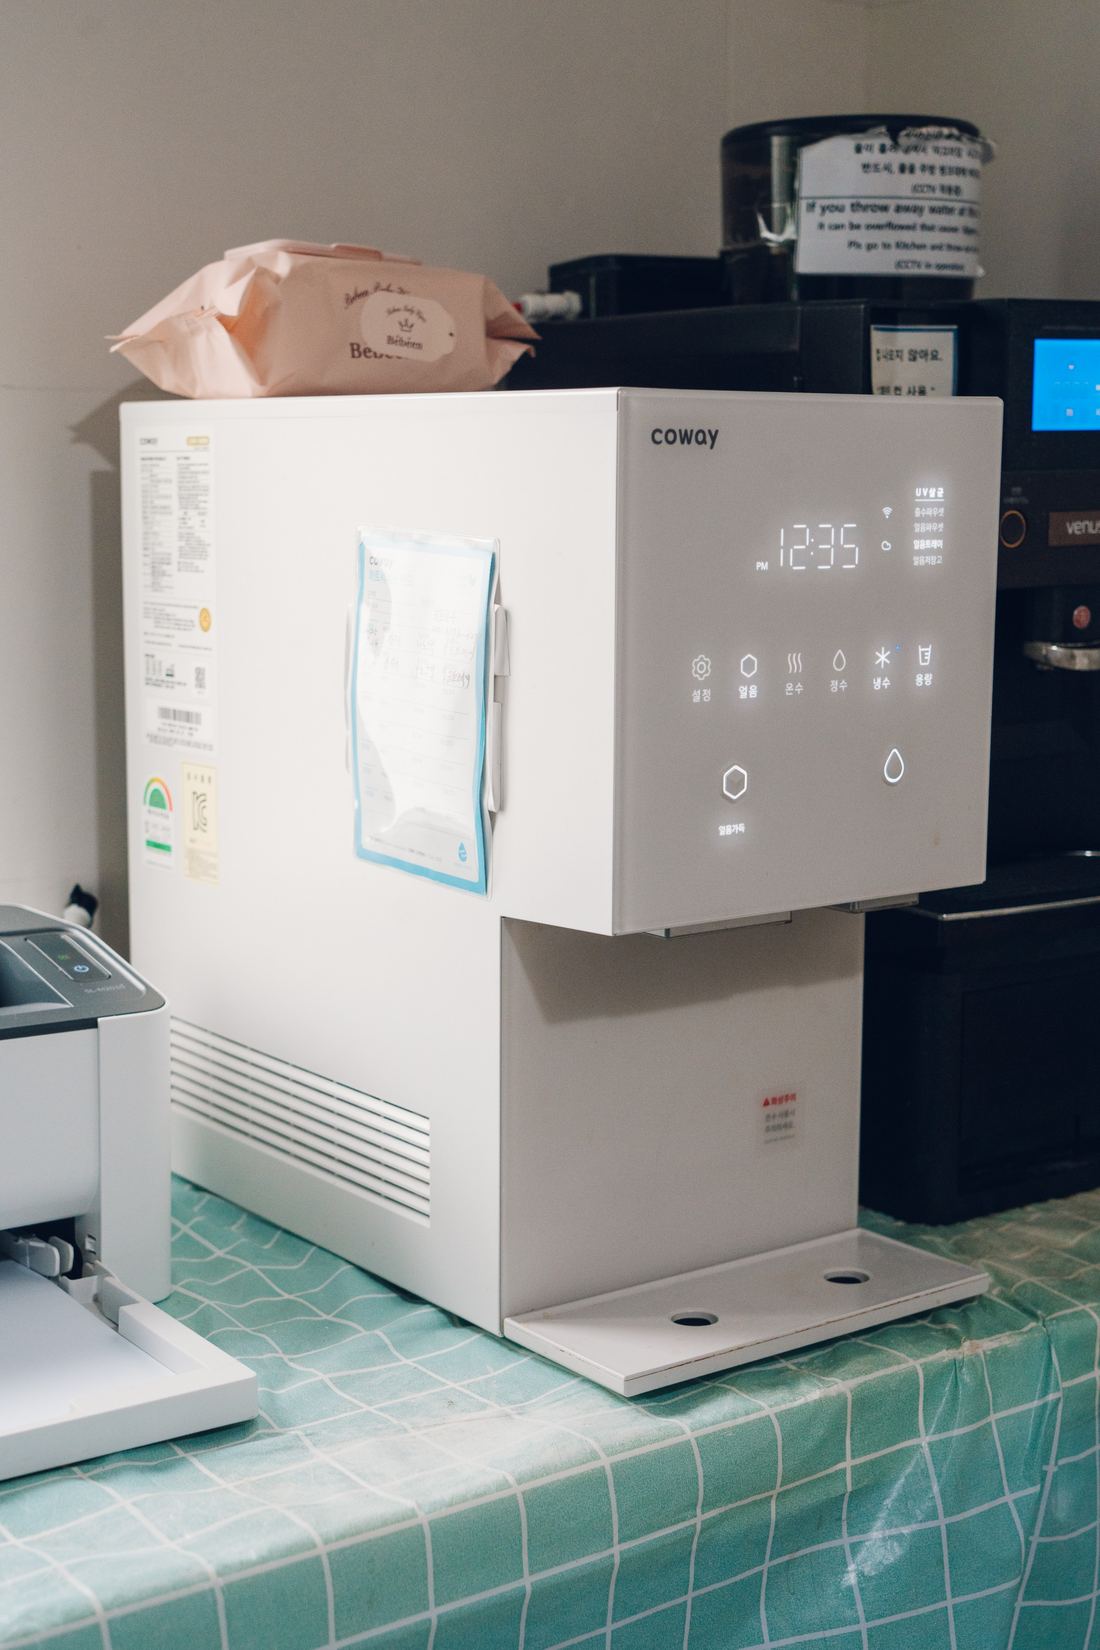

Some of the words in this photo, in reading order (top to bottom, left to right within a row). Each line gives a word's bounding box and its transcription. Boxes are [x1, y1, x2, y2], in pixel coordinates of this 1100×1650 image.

[820, 204, 846, 217] you
[850, 202, 889, 213] throw
[895, 204, 923, 218] away
[651, 428, 719, 450] coway
[756, 561, 769, 571] PM
[780, 524, 859, 570] 12:35
[830, 680, 848, 693] 정수
[873, 677, 891, 690] 냉수
[915, 673, 933, 687] 용량
[692, 688, 711, 703] 설정
[739, 684, 758, 699] 얼음
[785, 682, 804, 696] 온수
